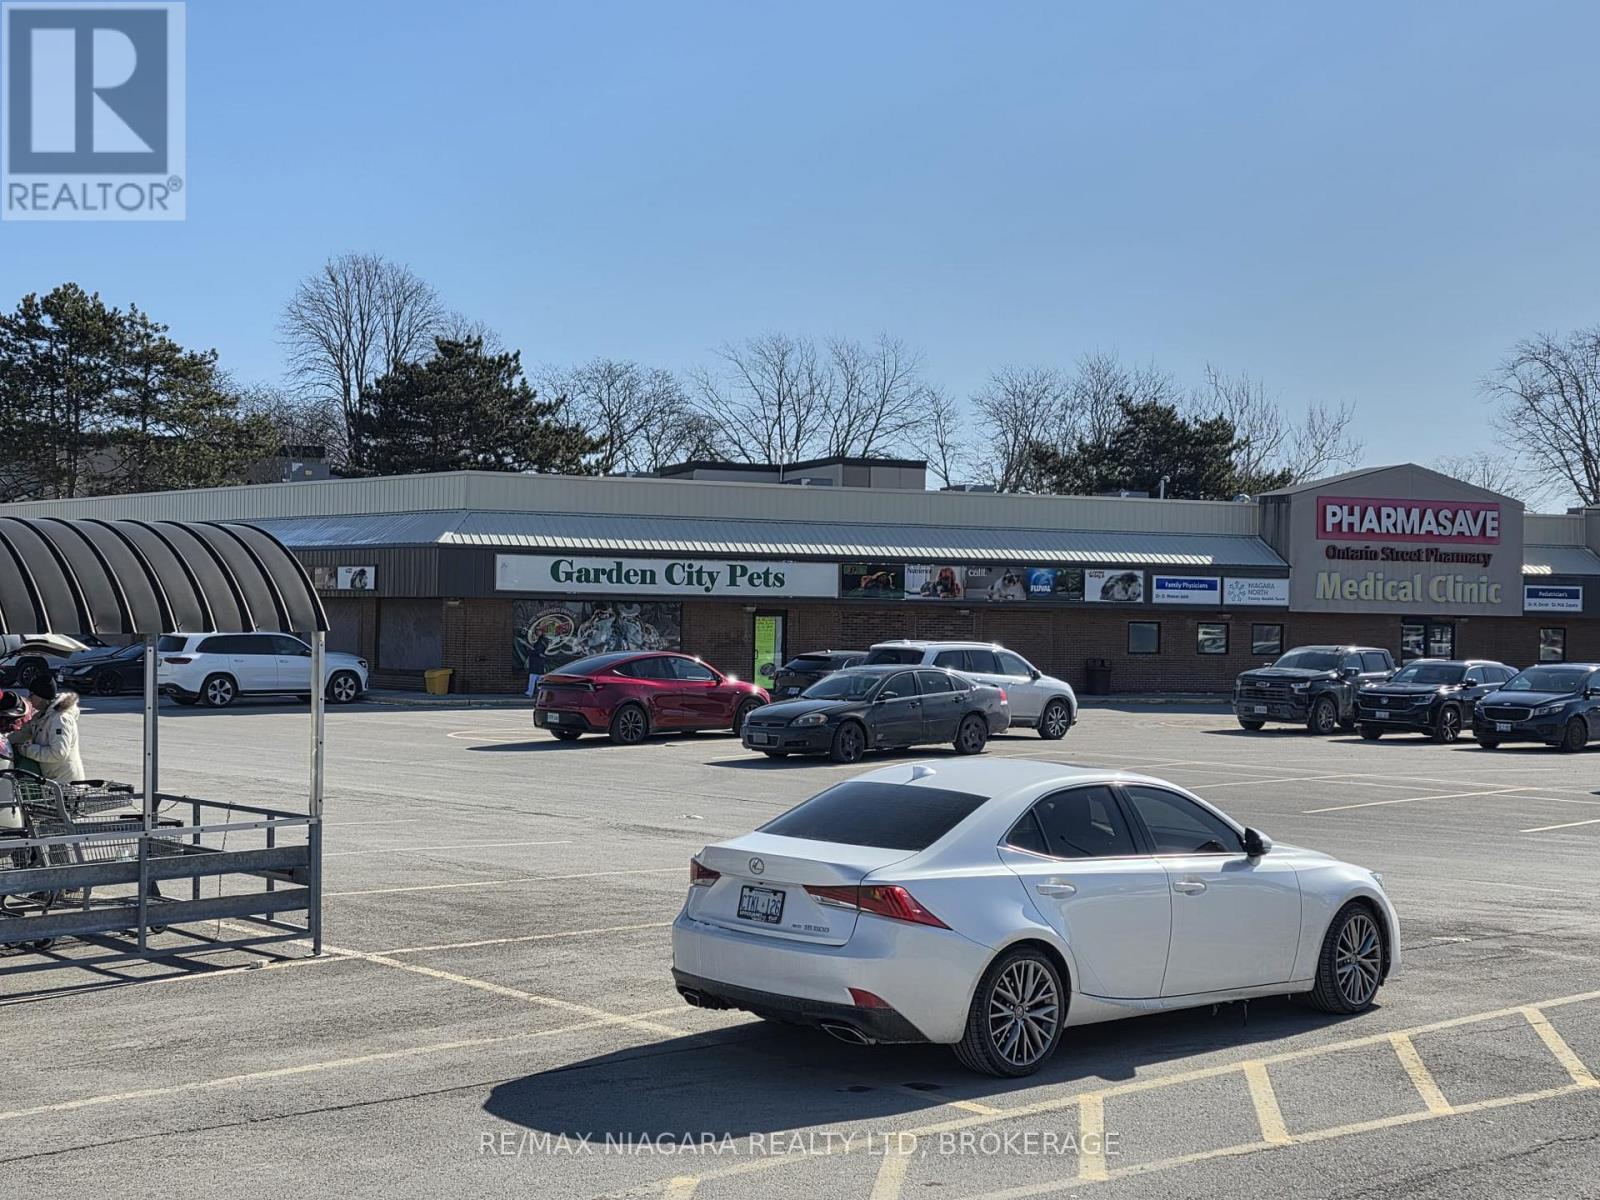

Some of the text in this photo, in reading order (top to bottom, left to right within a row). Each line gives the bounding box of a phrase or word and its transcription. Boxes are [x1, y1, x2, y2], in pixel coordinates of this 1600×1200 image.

[1325, 504, 1499, 537] PHARMASAVE
[1325, 544, 1493, 568] Ontario Street Pharmacy
[550, 558, 786, 593] Garden City Pets
[1165, 581, 1209, 590] Family Physicians
[1315, 571, 1502, 604] Medical Clinic
